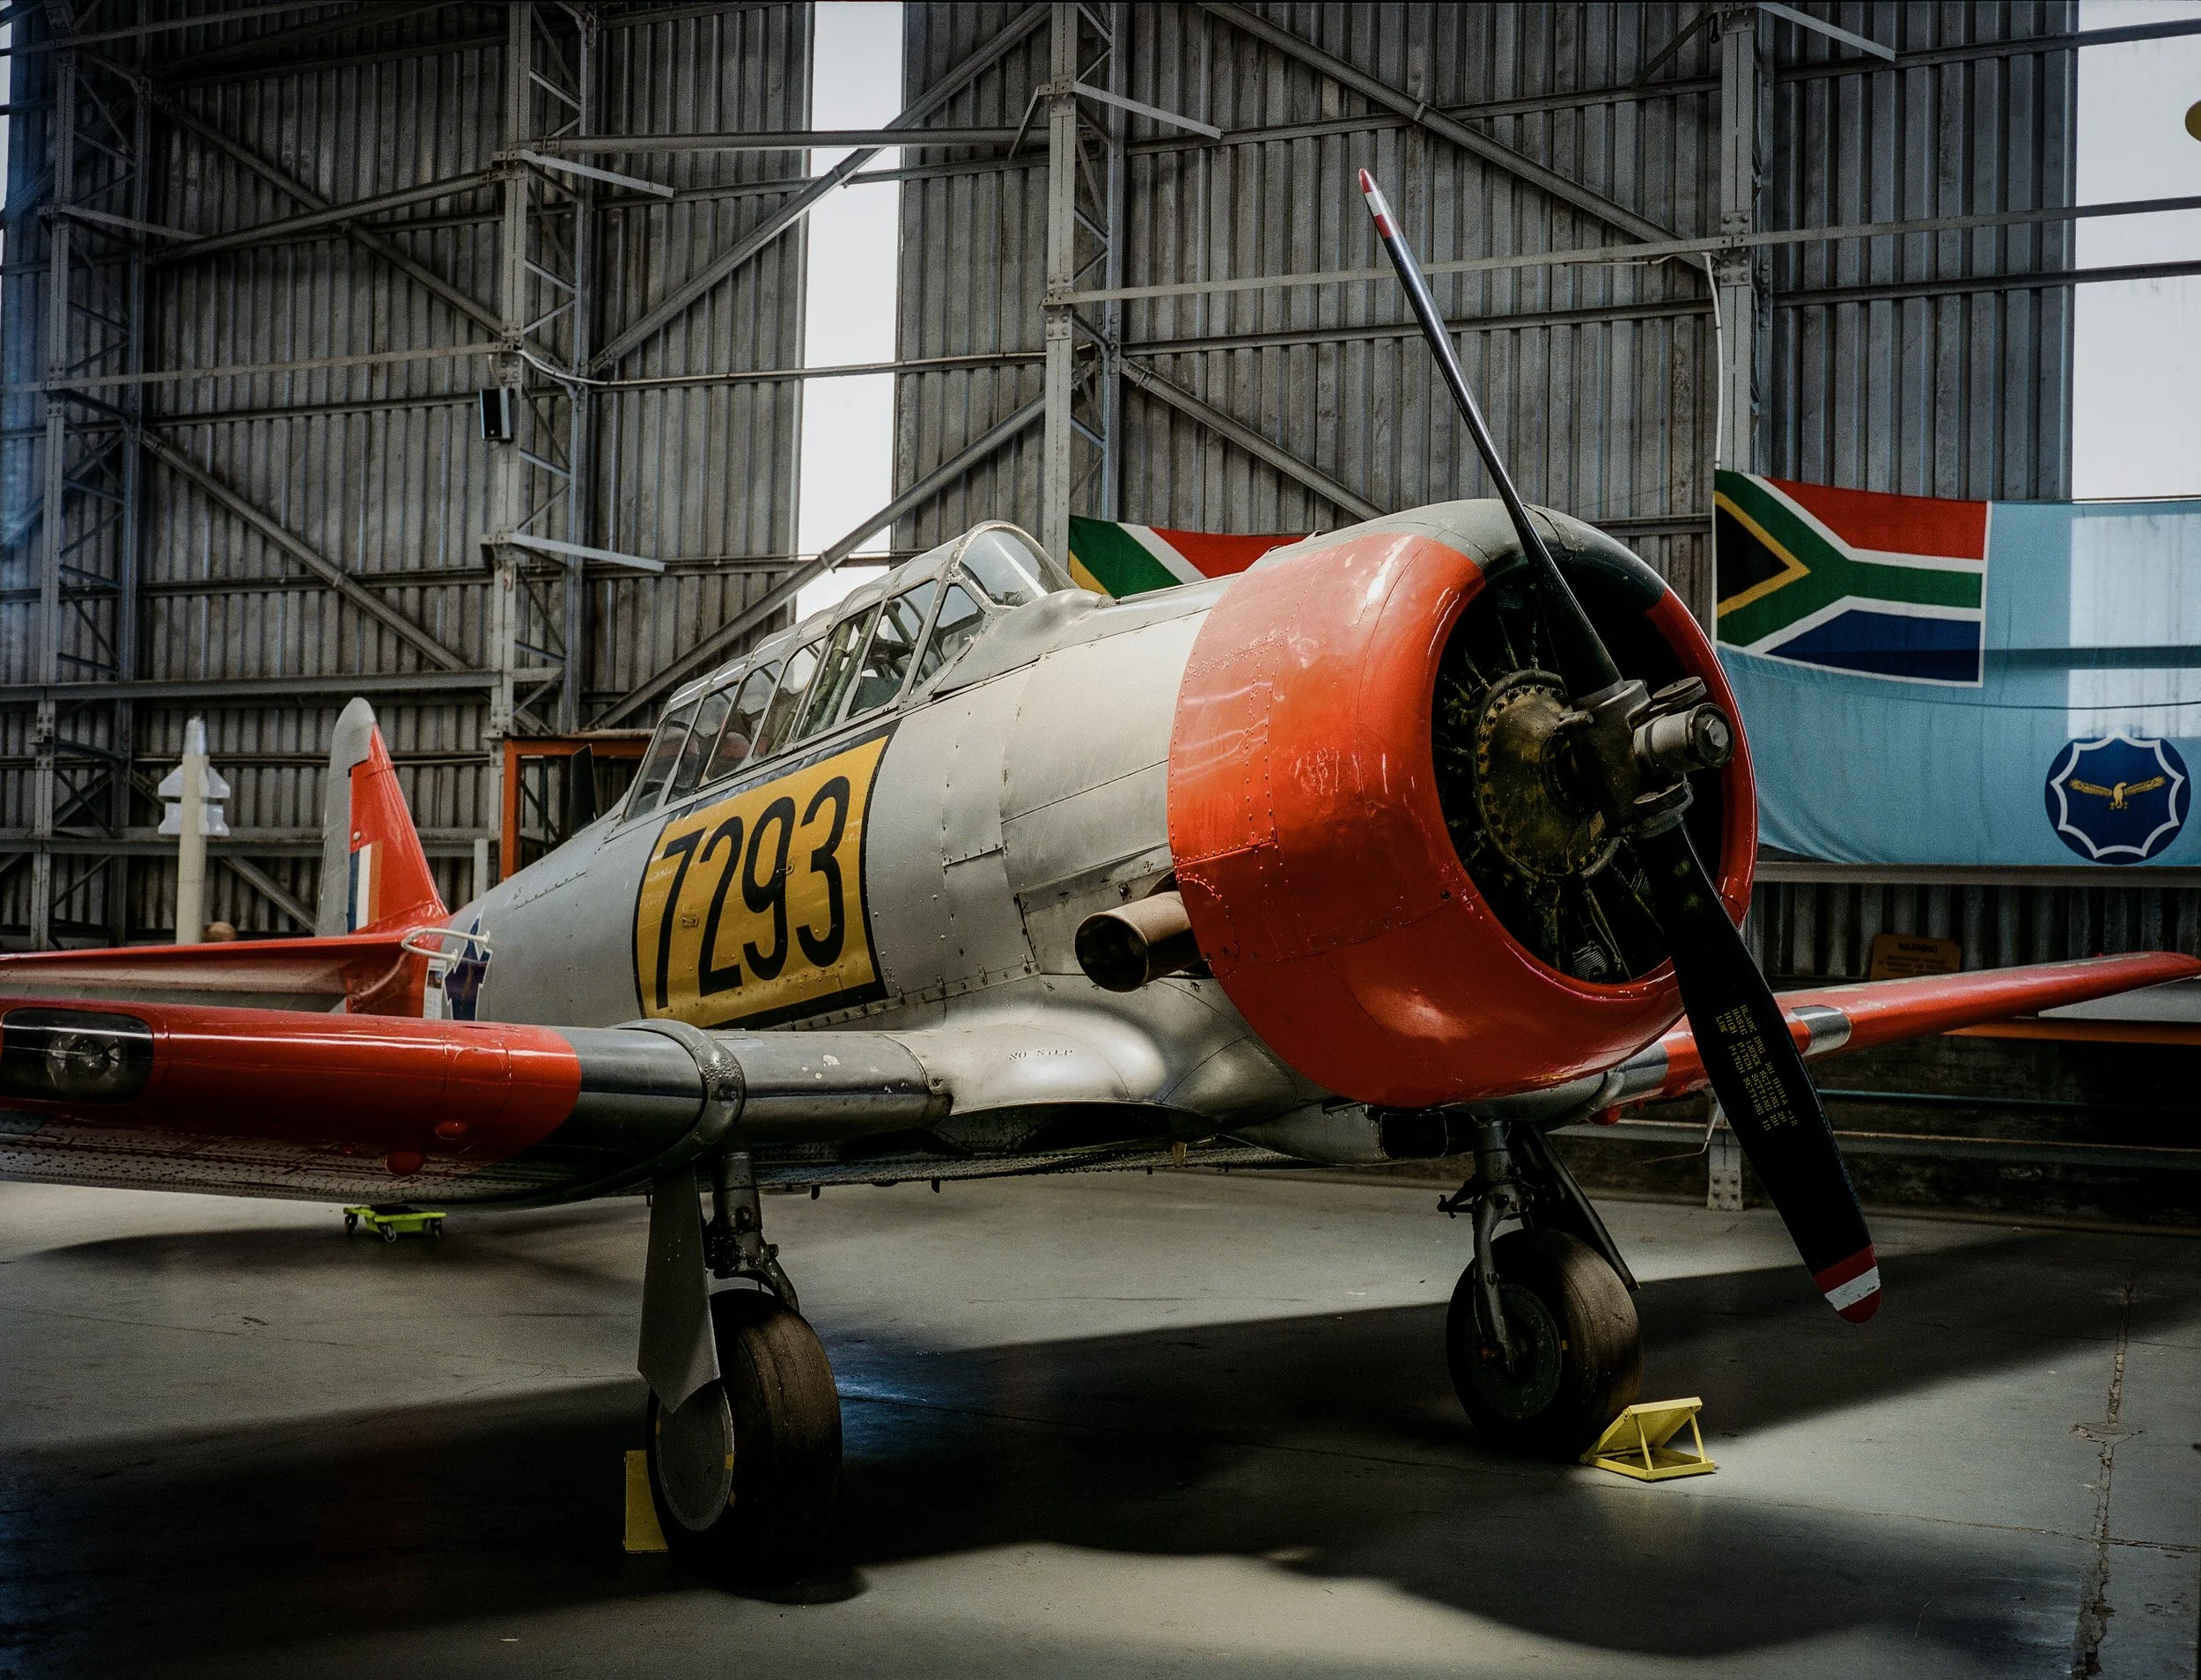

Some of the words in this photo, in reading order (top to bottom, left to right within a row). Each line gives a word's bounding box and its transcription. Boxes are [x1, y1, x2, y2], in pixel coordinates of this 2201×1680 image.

[656, 776, 850, 1010] 7293
[1009, 1051, 1027, 1061] NO
[1715, 1015, 1728, 1033] LOW
[1728, 1045, 1746, 1074] PITCH
[1742, 1076, 1764, 1116] SETTING
[1723, 1012, 1738, 1034] HIGH
[1736, 1042, 1754, 1071] PITCH
[1751, 1072, 1772, 1111] SETTING
[1732, 1008, 1748, 1035] BASIC
[1745, 1040, 1762, 1067] INDEX
[1759, 1070, 1780, 1108] SETTING
[1740, 1004, 1757, 1033] BLADE
